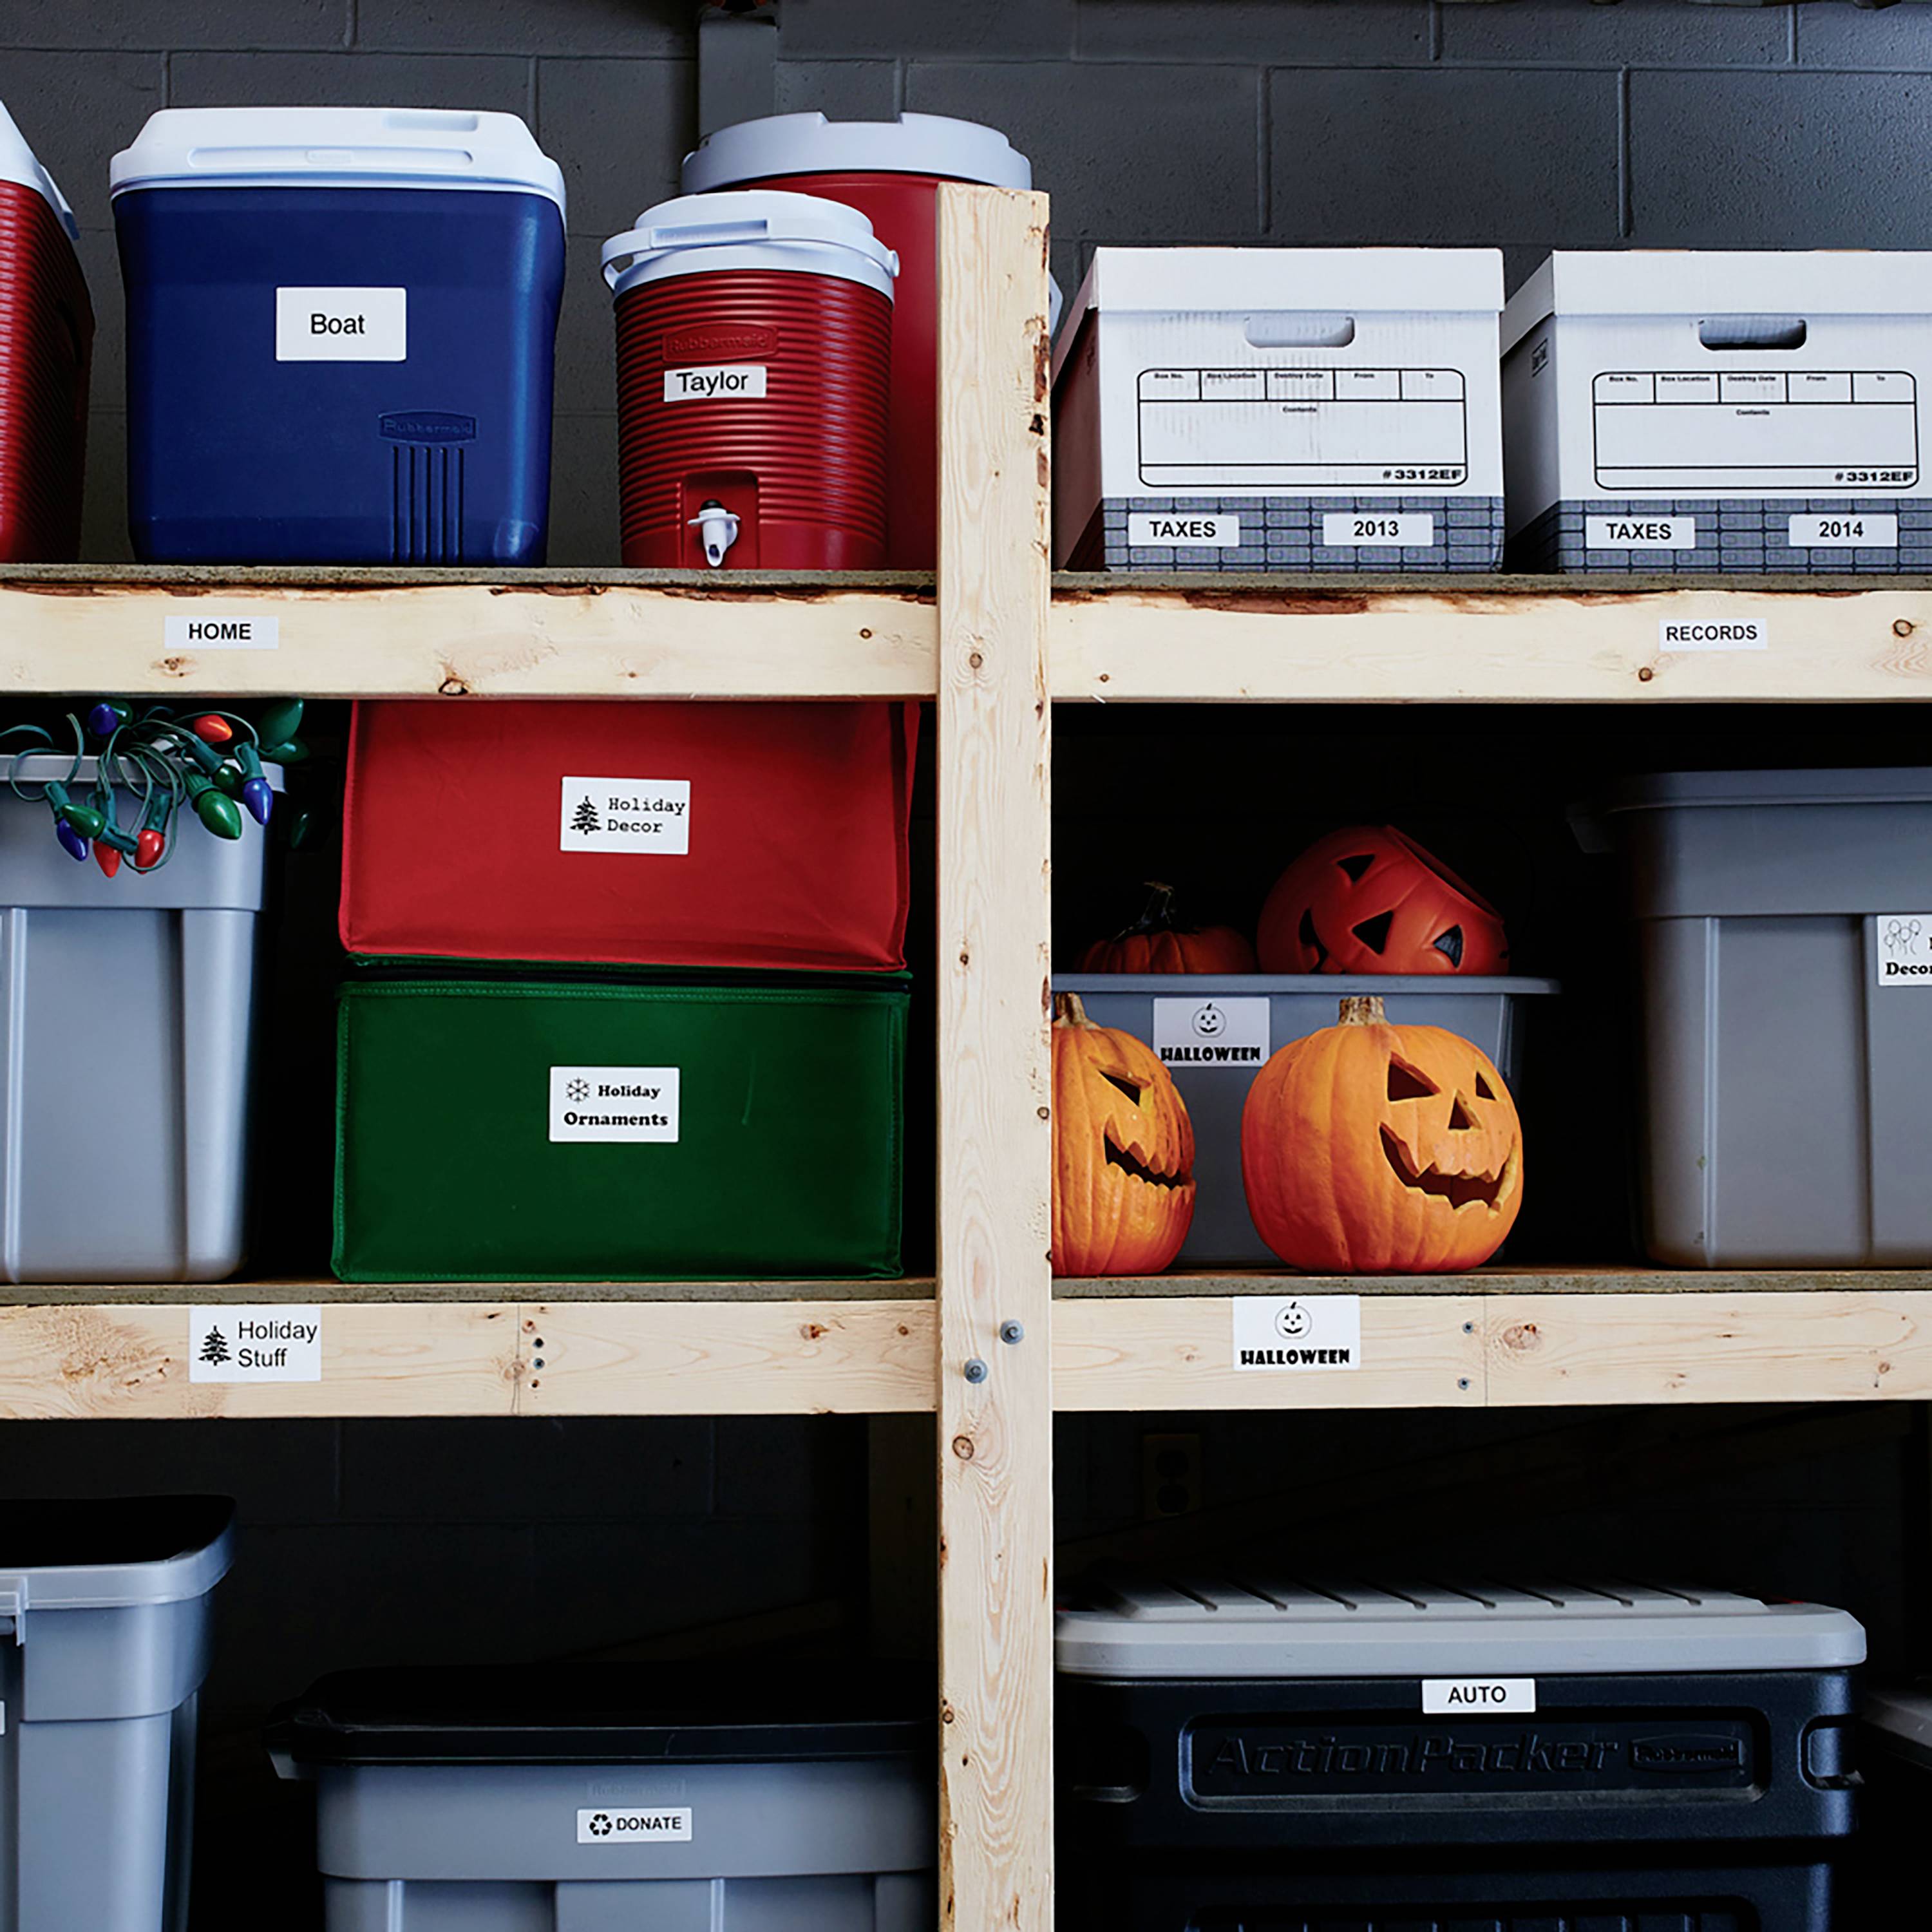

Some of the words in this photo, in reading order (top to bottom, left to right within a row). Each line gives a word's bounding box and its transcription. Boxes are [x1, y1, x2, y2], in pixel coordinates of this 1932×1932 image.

[310, 313, 365, 335] Boat
[676, 370, 749, 397] Taylor
[1149, 520, 1217, 538] TAXES
[1354, 520, 1399, 537] 2013
[1606, 522, 1672, 540] TAXES
[1819, 521, 1864, 538] 2014
[189, 623, 252, 640] HOME
[1666, 625, 1757, 641] RECORDS
[609, 797, 687, 817] Holiday
[608, 819, 663, 833] Decor
[1160, 1046, 1260, 1061] HALLOWEEN
[598, 1084, 661, 1100] Holiday
[564, 1112, 668, 1126] Ornaments
[238, 1320, 317, 1346] Holiday
[238, 1347, 288, 1368] Stuff
[1240, 1349, 1350, 1365] HALLOWEEN
[1448, 1685, 1506, 1703] AUTO
[1204, 1731, 1622, 1776] ActionPacker
[616, 1816, 683, 1830] DONATE
